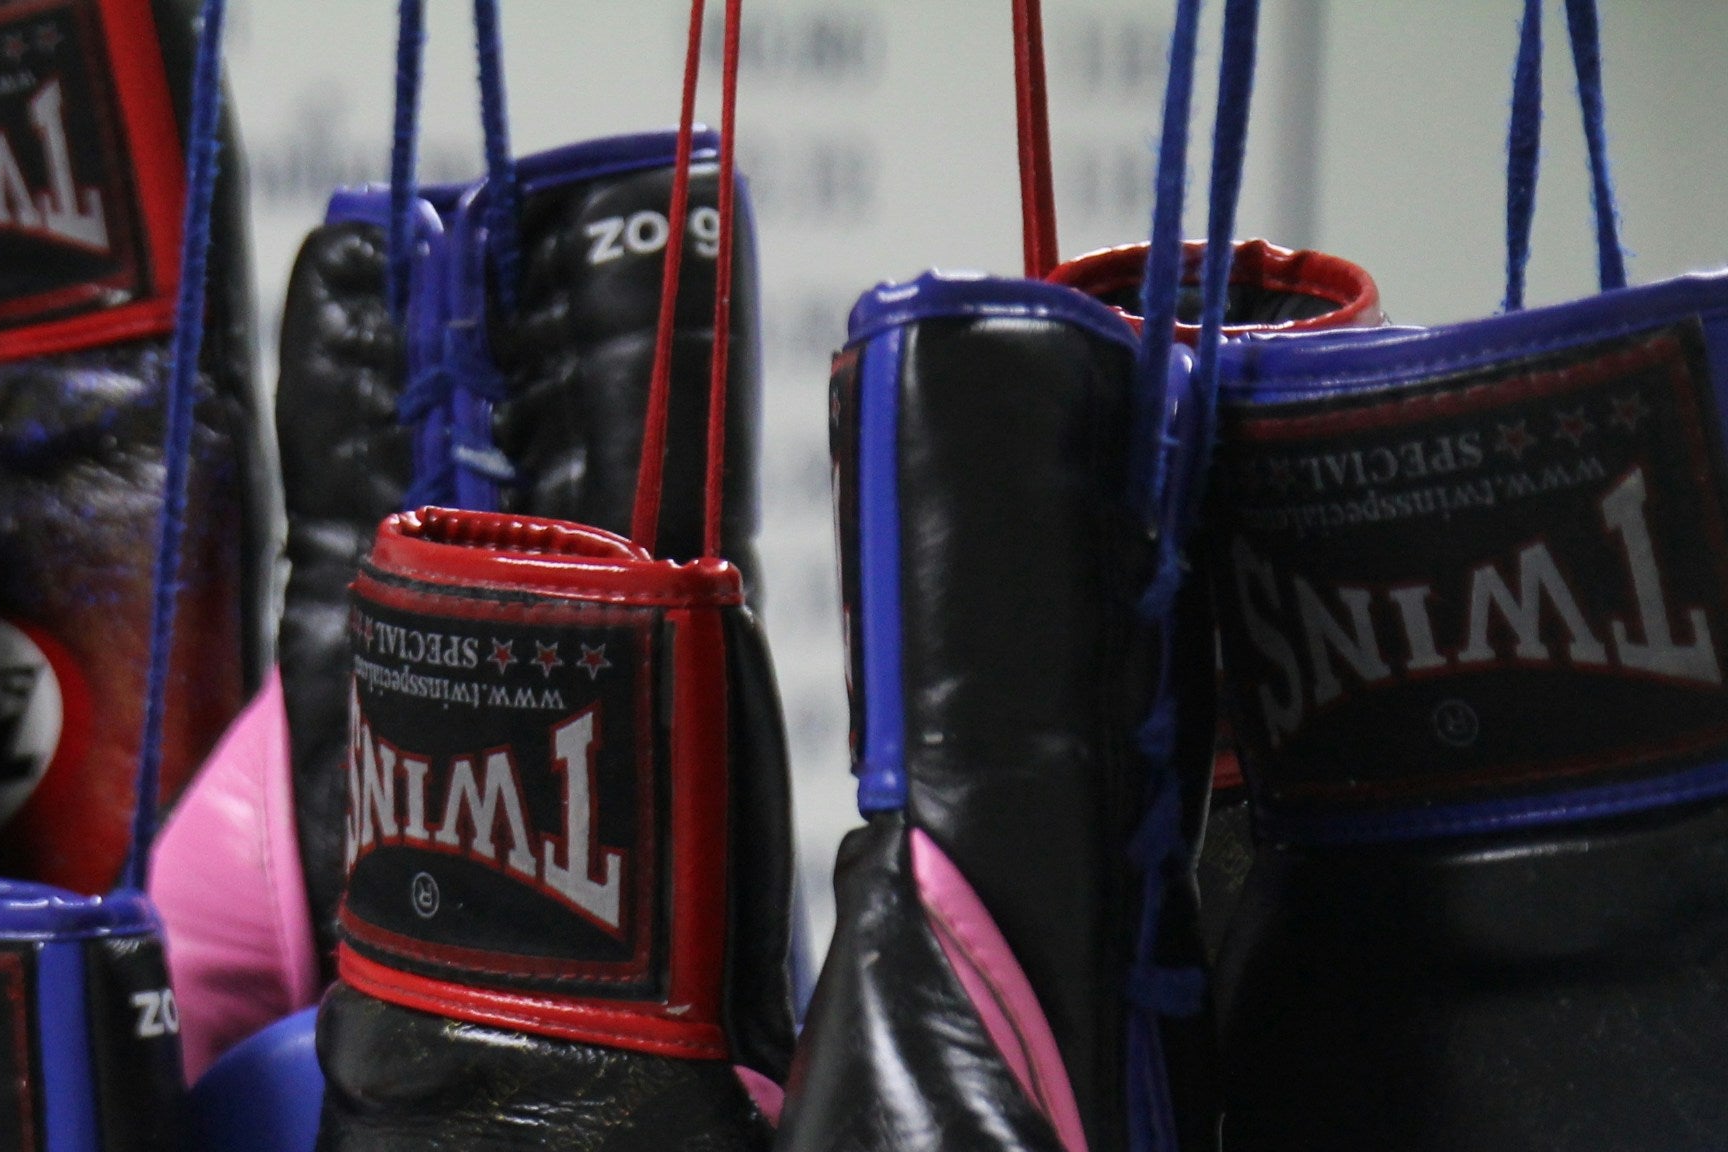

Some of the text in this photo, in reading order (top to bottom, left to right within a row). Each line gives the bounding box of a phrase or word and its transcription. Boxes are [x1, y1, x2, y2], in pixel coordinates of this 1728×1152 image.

[584, 209, 669, 264] OZ
[1298, 431, 1484, 491] SPECIAL
[1229, 466, 1723, 750] TWINS
[374, 621, 480, 669] SPECIAL
[129, 986, 180, 1039] OZ
